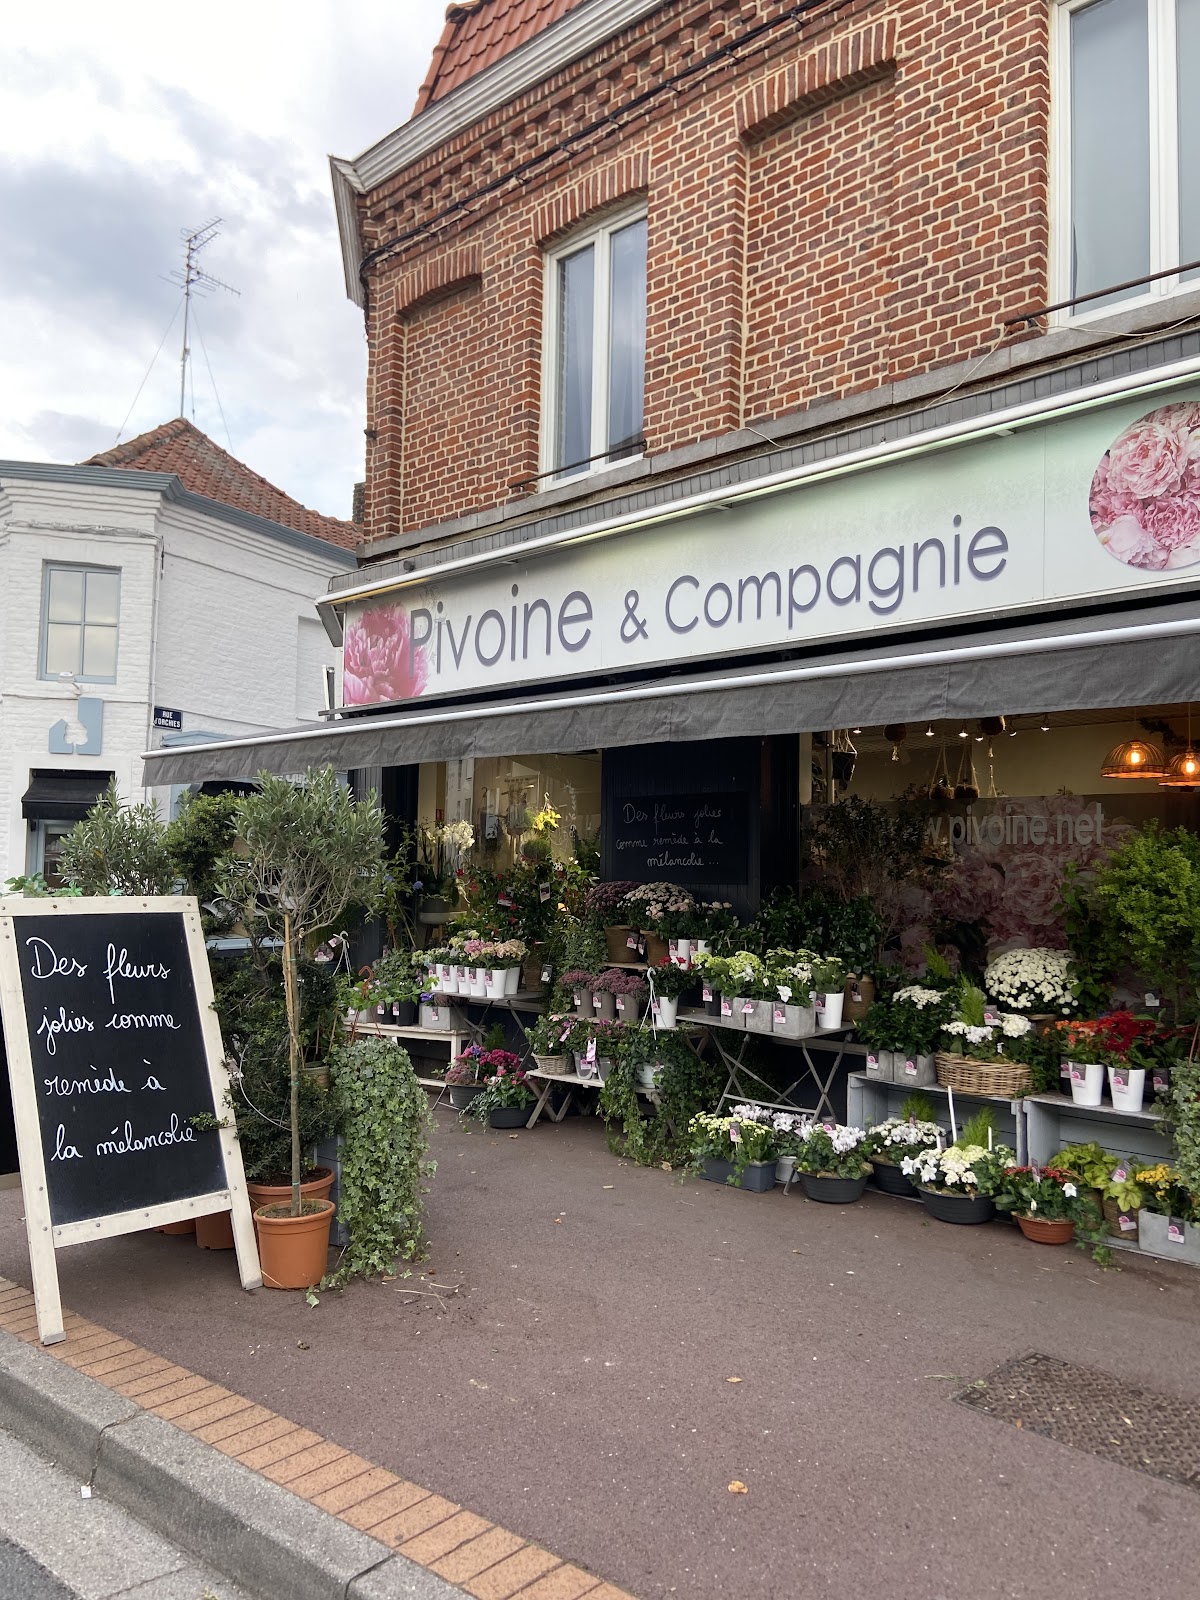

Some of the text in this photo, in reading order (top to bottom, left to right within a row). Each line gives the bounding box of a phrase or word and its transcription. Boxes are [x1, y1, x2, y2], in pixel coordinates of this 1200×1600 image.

[408, 514, 1009, 679] Pivoine & Compagnie
[616, 829, 724, 850] comme remède à la
[622, 803, 722, 835] Des fleurs jolies
[26, 936, 171, 1004] Des fleurs
[37, 1007, 181, 1055] jolies comme
[45, 1058, 167, 1096] remède à
[51, 1113, 198, 1161] la mélancolie
